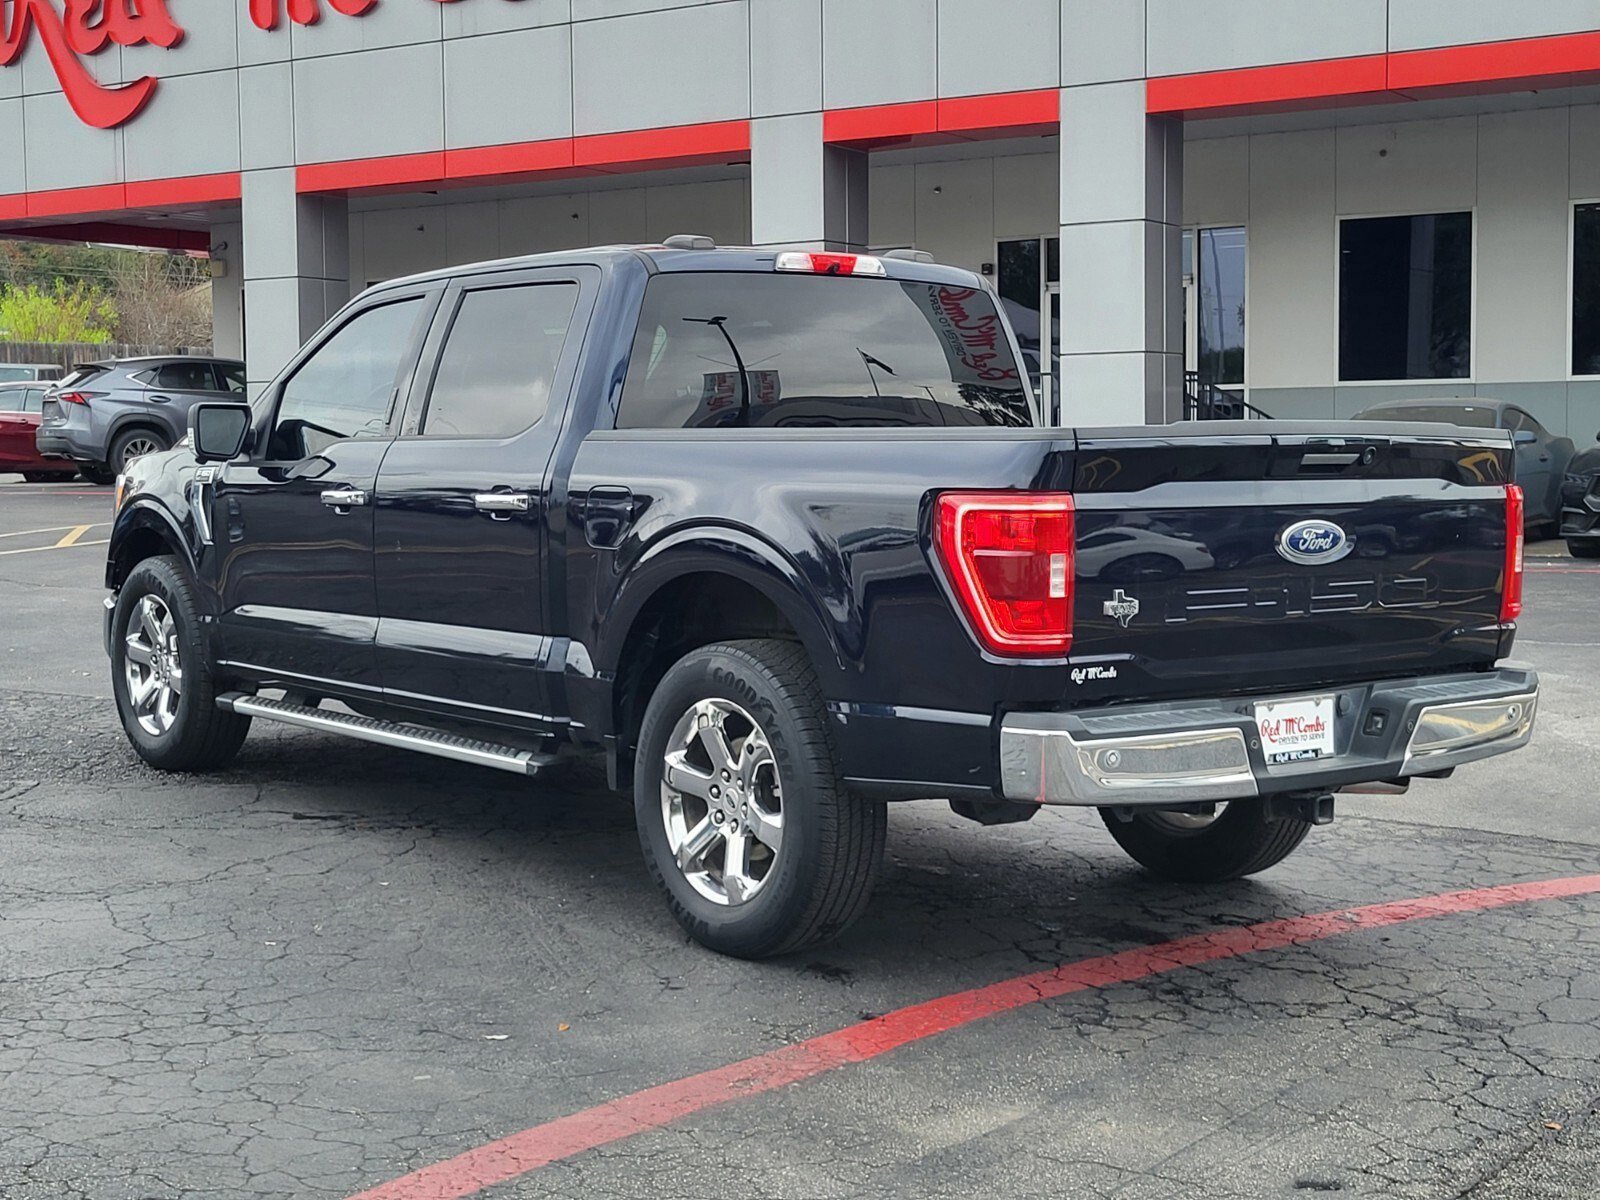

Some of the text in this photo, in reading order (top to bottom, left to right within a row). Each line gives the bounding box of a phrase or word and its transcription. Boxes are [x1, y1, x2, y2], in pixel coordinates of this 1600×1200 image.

[1299, 528, 1334, 551] Ford
[1261, 716, 1325, 743] Red McCombs
[1278, 732, 1325, 745] DRIVEN TO SERVE
